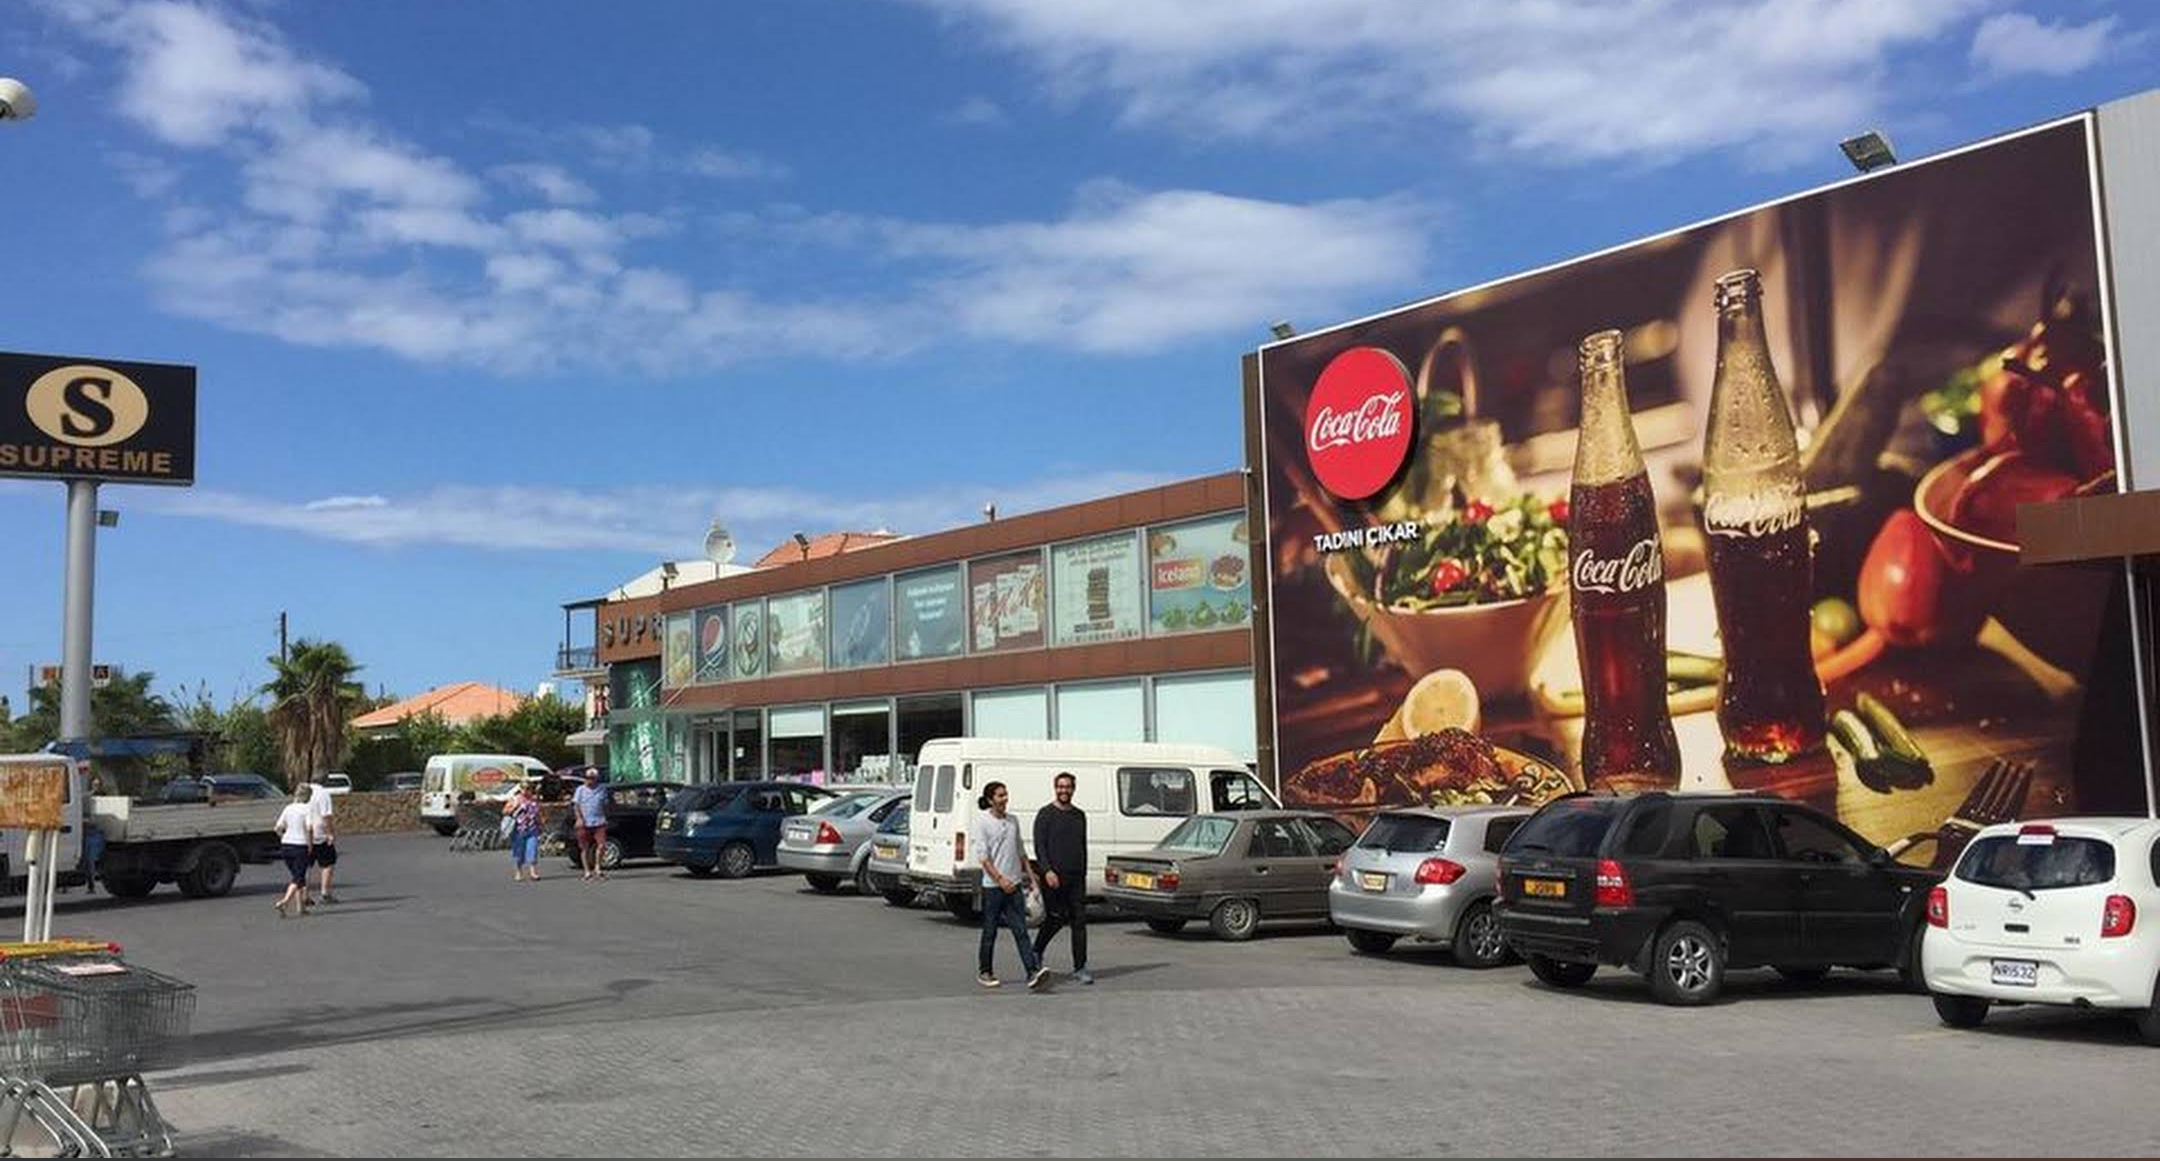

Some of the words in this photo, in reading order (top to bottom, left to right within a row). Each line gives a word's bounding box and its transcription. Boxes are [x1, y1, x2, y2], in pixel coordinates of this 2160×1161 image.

[61, 377, 114, 437] S
[1311, 391, 1405, 451] Coca-Cola
[0, 445, 171, 474] SUPREME
[1313, 527, 1363, 551] TADINI
[1366, 521, 1418, 548] ÇIKAR
